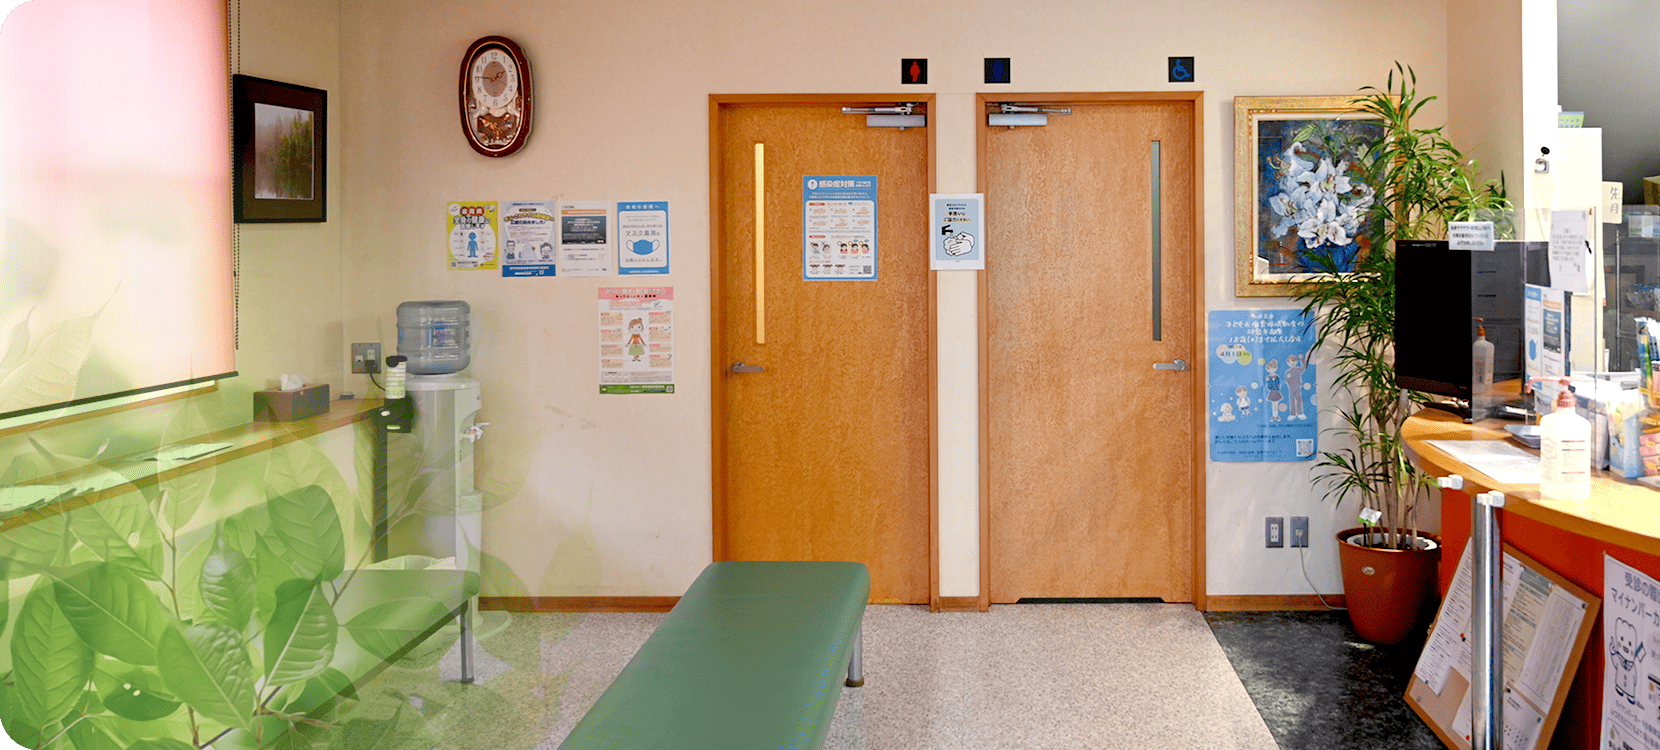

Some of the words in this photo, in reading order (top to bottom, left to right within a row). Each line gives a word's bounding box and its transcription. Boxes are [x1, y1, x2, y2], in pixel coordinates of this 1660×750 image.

[819, 180, 855, 188] 感染症対策
[1610, 186, 1621, 214] 先月
[1625, 571, 1660, 604] 受診の際
